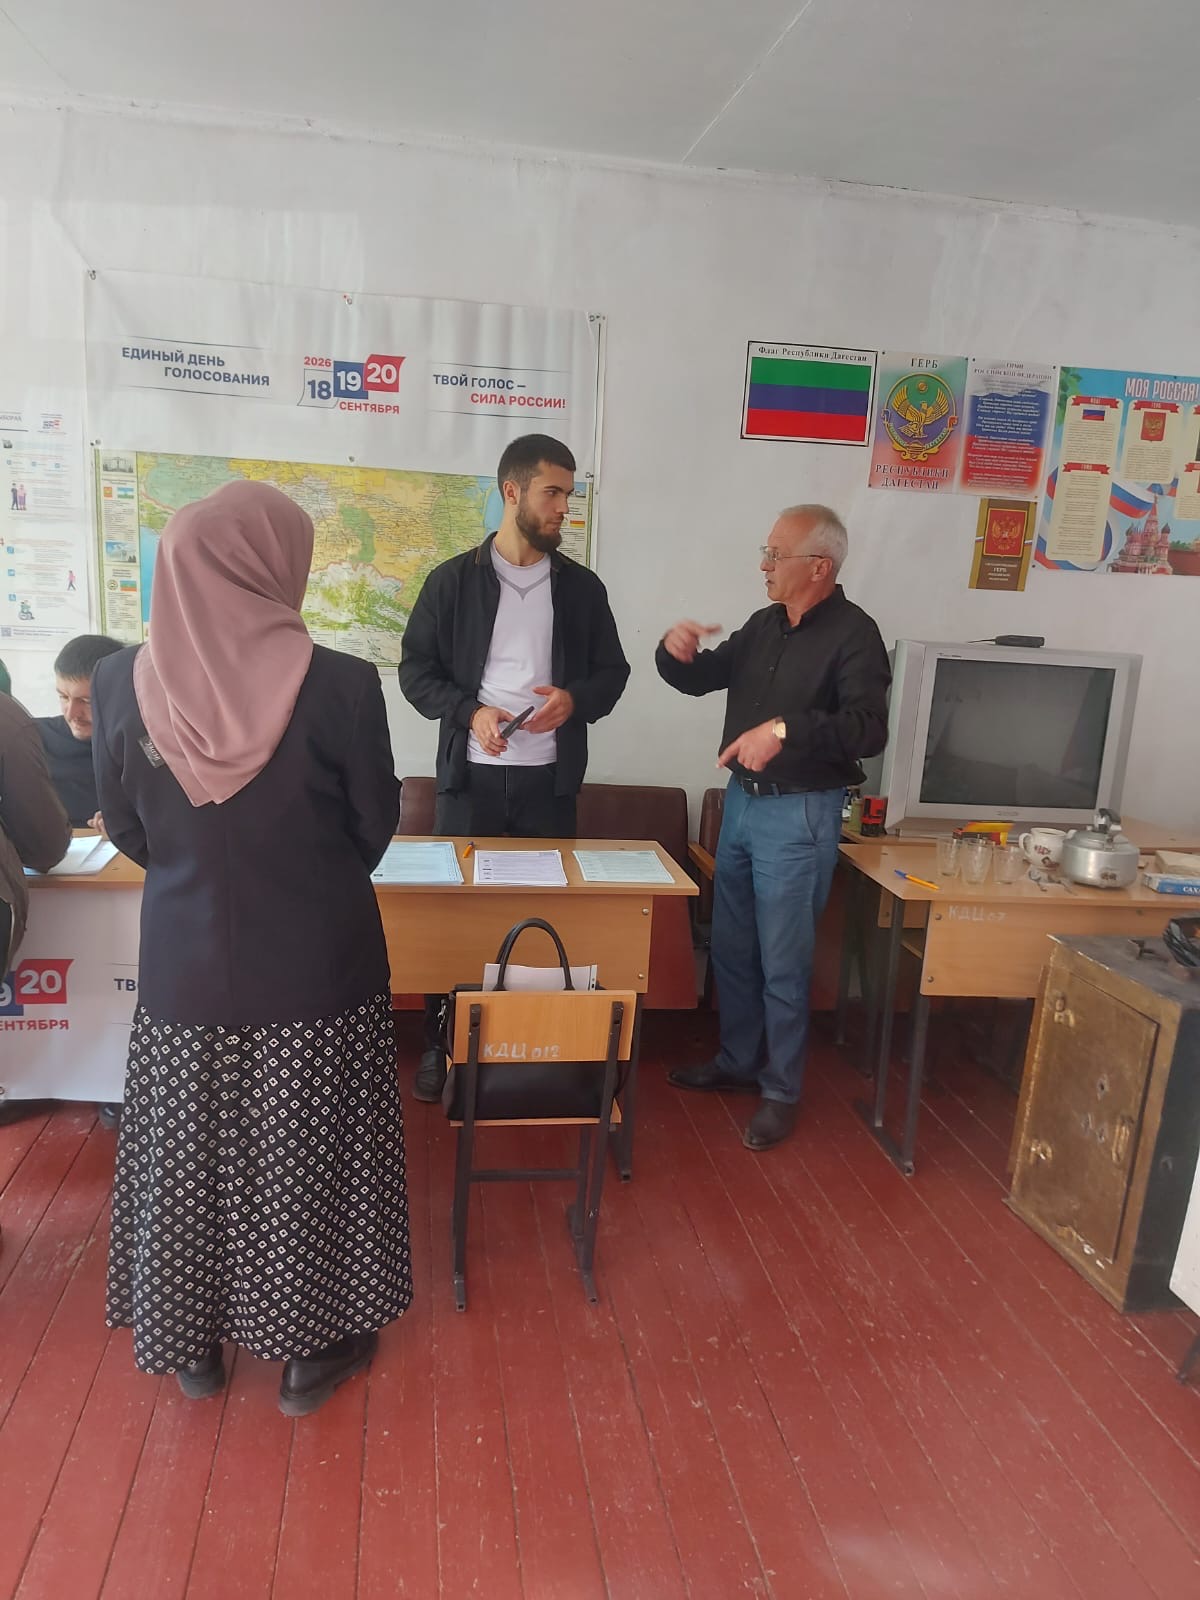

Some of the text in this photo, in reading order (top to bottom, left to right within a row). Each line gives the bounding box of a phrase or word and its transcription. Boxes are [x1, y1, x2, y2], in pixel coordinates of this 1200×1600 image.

[122, 347, 226, 367] ЕДИНЫЙ ДЕНЬ
[303, 356, 332, 367] 2026
[758, 346, 868, 361] Флаг Республики Дагестан
[911, 358, 939, 369] ГЕРБ
[164, 366, 270, 386] ГОЛОСОВАНИЯ
[336, 370, 362, 392] 19
[366, 362, 398, 385] 20
[433, 373, 468, 387] ТВОЙ
[471, 377, 514, 390] ГОЛОС
[307, 379, 332, 400] 18
[1124, 377, 1199, 402] МОЯ РОССИЯ!
[339, 401, 400, 415] СЕНТЯБРЯ
[470, 392, 566, 409] СИЛА РОССИИ!
[881, 477, 939, 490] ДАГЕСТАН
[19, 969, 63, 995] 20
[113, 978, 138, 992] ТВ
[483, 1042, 528, 1059] КДЦ
